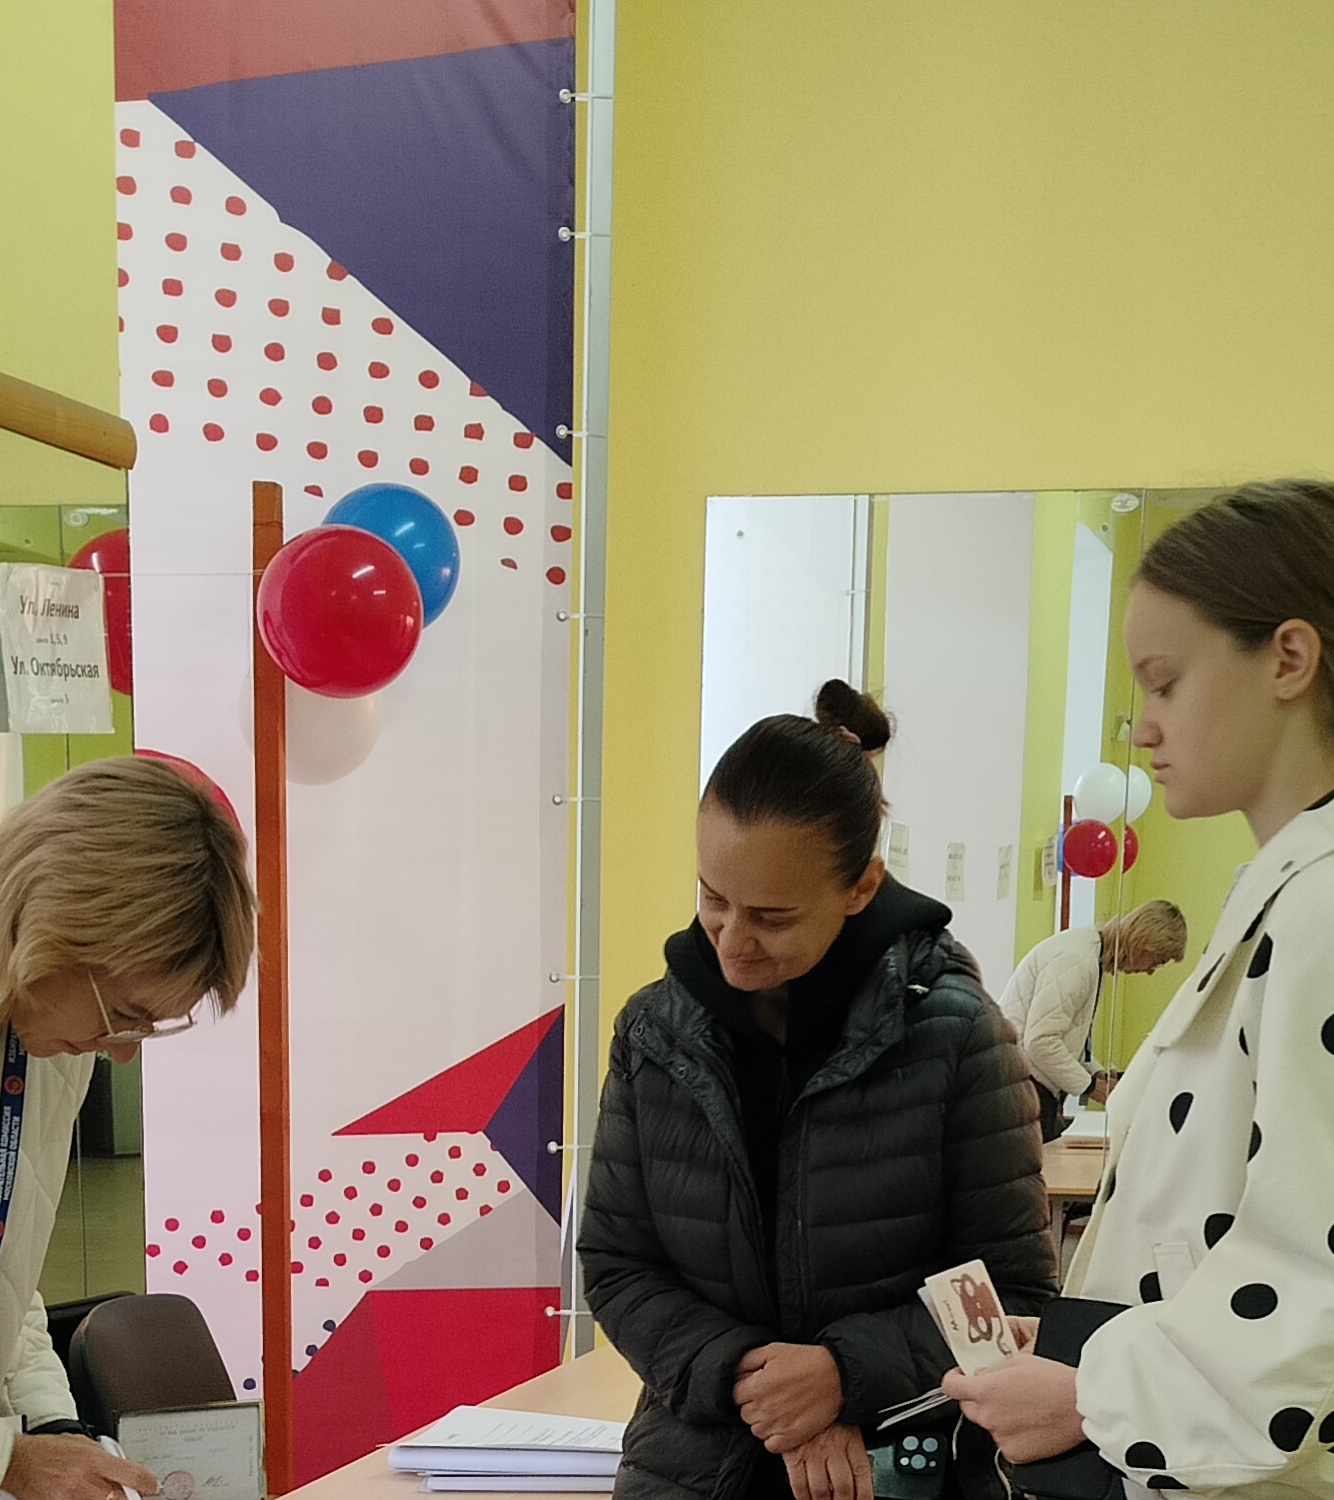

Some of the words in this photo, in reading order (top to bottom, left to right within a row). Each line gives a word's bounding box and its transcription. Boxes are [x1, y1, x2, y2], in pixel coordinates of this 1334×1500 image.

[19, 595, 38, 616] Ул.
[40, 598, 80, 619] Ленина
[11, 655, 29, 676] Ул.
[30, 658, 100, 682] Октябрьская
[0, 1105, 12, 1147] КОМИССИЯ
[9, 1116, 20, 1151] ОБЛАСТИ
